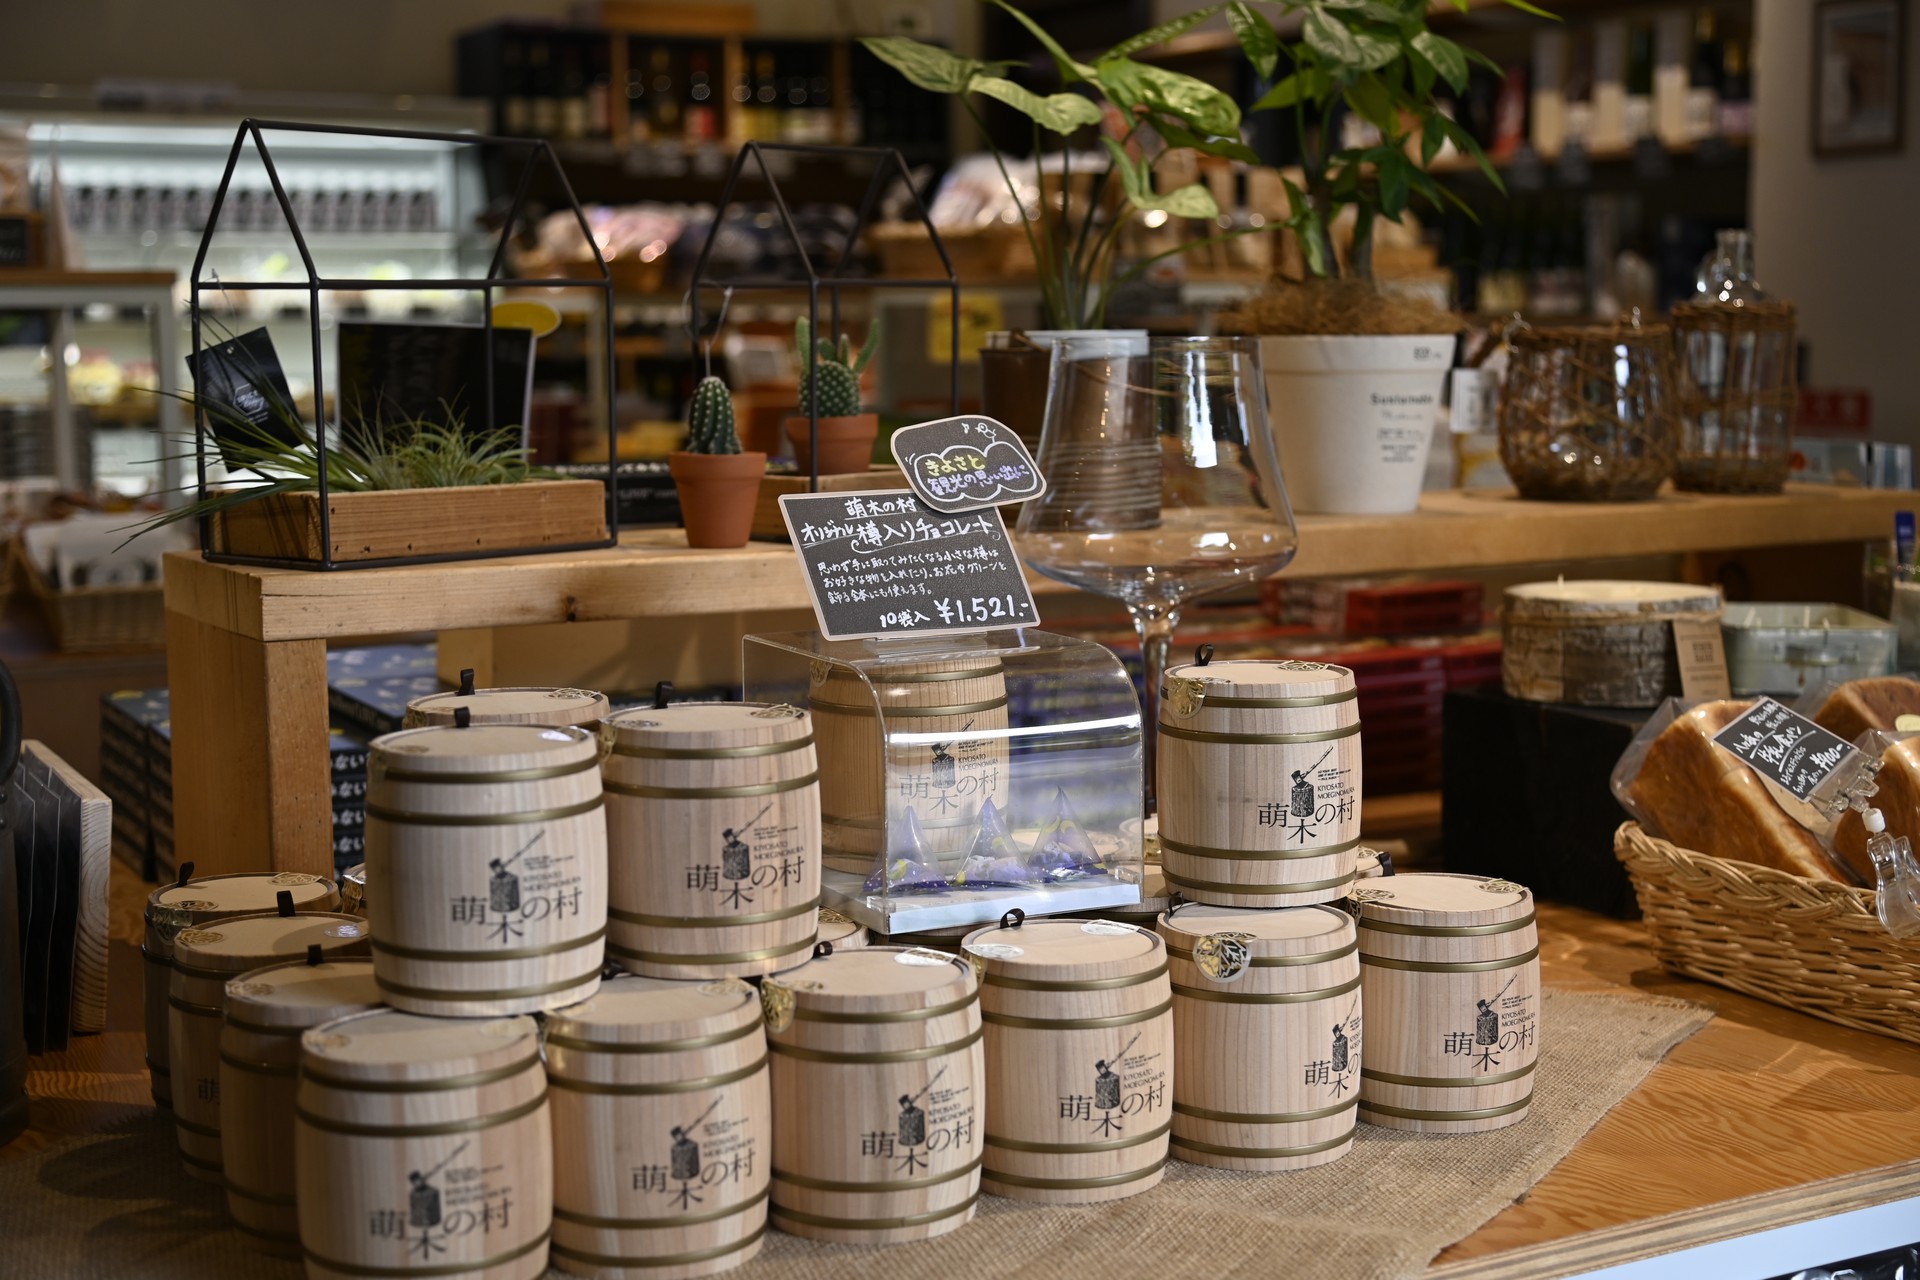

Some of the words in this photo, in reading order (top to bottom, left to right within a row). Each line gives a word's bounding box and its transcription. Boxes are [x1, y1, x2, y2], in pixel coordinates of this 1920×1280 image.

[925, 454, 986, 477] きよさと
[927, 464, 1030, 496] 観光の思い出に
[844, 496, 917, 518] 萌木の村
[880, 608, 930, 628] 10袋入
[899, 767, 999, 815] 萌木の村
[1317, 782, 1344, 792] KIYOSATO
[1257, 795, 1355, 844] 萌木の村
[685, 856, 805, 910] 萌木の村
[1443, 1021, 1536, 1072] 萌木の村
[1059, 1081, 1166, 1138] 萌木の村
[861, 1115, 975, 1176] 萌木の村
